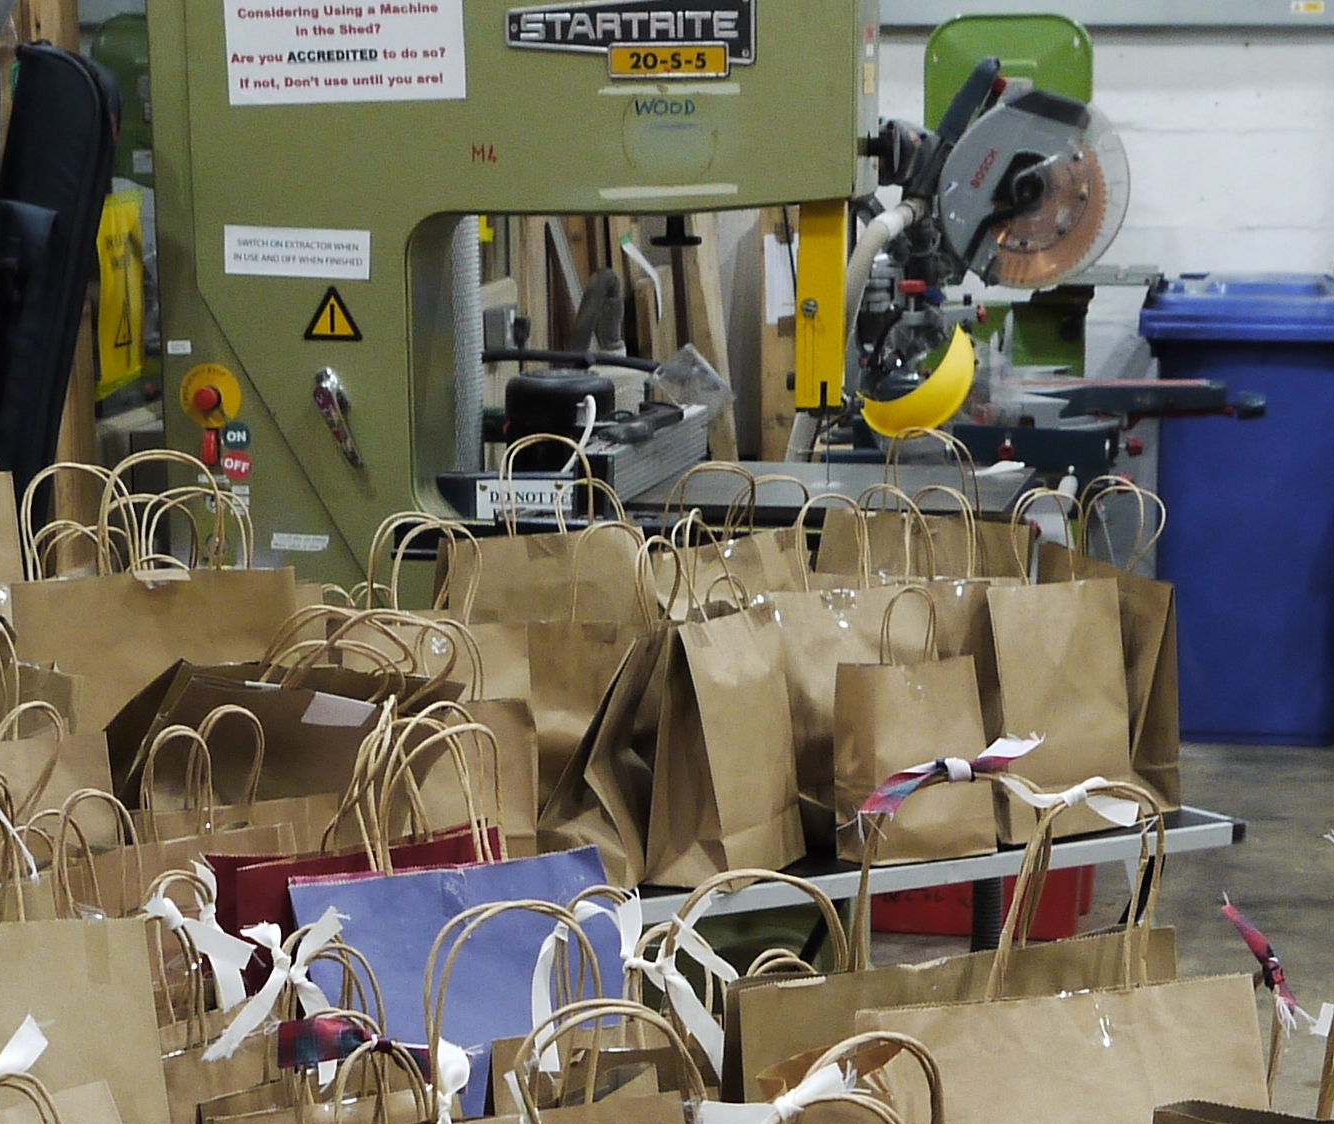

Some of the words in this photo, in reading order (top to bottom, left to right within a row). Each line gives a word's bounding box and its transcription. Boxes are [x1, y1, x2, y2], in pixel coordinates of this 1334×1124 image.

[237, 6, 319, 19] Considering
[323, 4, 363, 17] Using
[367, 6, 376, 15] a
[380, 3, 439, 14] Machine
[312, 24, 335, 36] the
[339, 23, 381, 35] Shed?
[520, 10, 739, 41] STARTRITE
[231, 52, 254, 64] Are
[258, 53, 283, 66] you
[287, 49, 378, 63] ACCREDITED
[383, 48, 396, 60] to
[401, 48, 418, 60] do
[422, 47, 446, 59] so?
[629, 52, 707, 70] 20-S-5
[240, 78, 249, 89] If
[253, 78, 280, 90] not,
[284, 76, 319, 88] Don't
[324, 78, 348, 87] use
[352, 74, 383, 86] until
[388, 75, 412, 87] you
[416, 73, 443, 84] are!
[635, 98, 695, 116] WOOD
[237, 238, 268, 249] SWITCH
[270, 239, 283, 249] ON
[284, 240, 332, 250] EXTRACTOR
[333, 242, 359, 251] WHEN
[233, 252, 242, 261] IN
[243, 253, 258, 262] USE
[261, 253, 280, 263] AND
[281, 254, 296, 263] OFF
[298, 255, 323, 265] WHEN
[325, 257, 363, 266] FINISHED
[226, 430, 247, 442] ON
[223, 457, 250, 473] OFF
